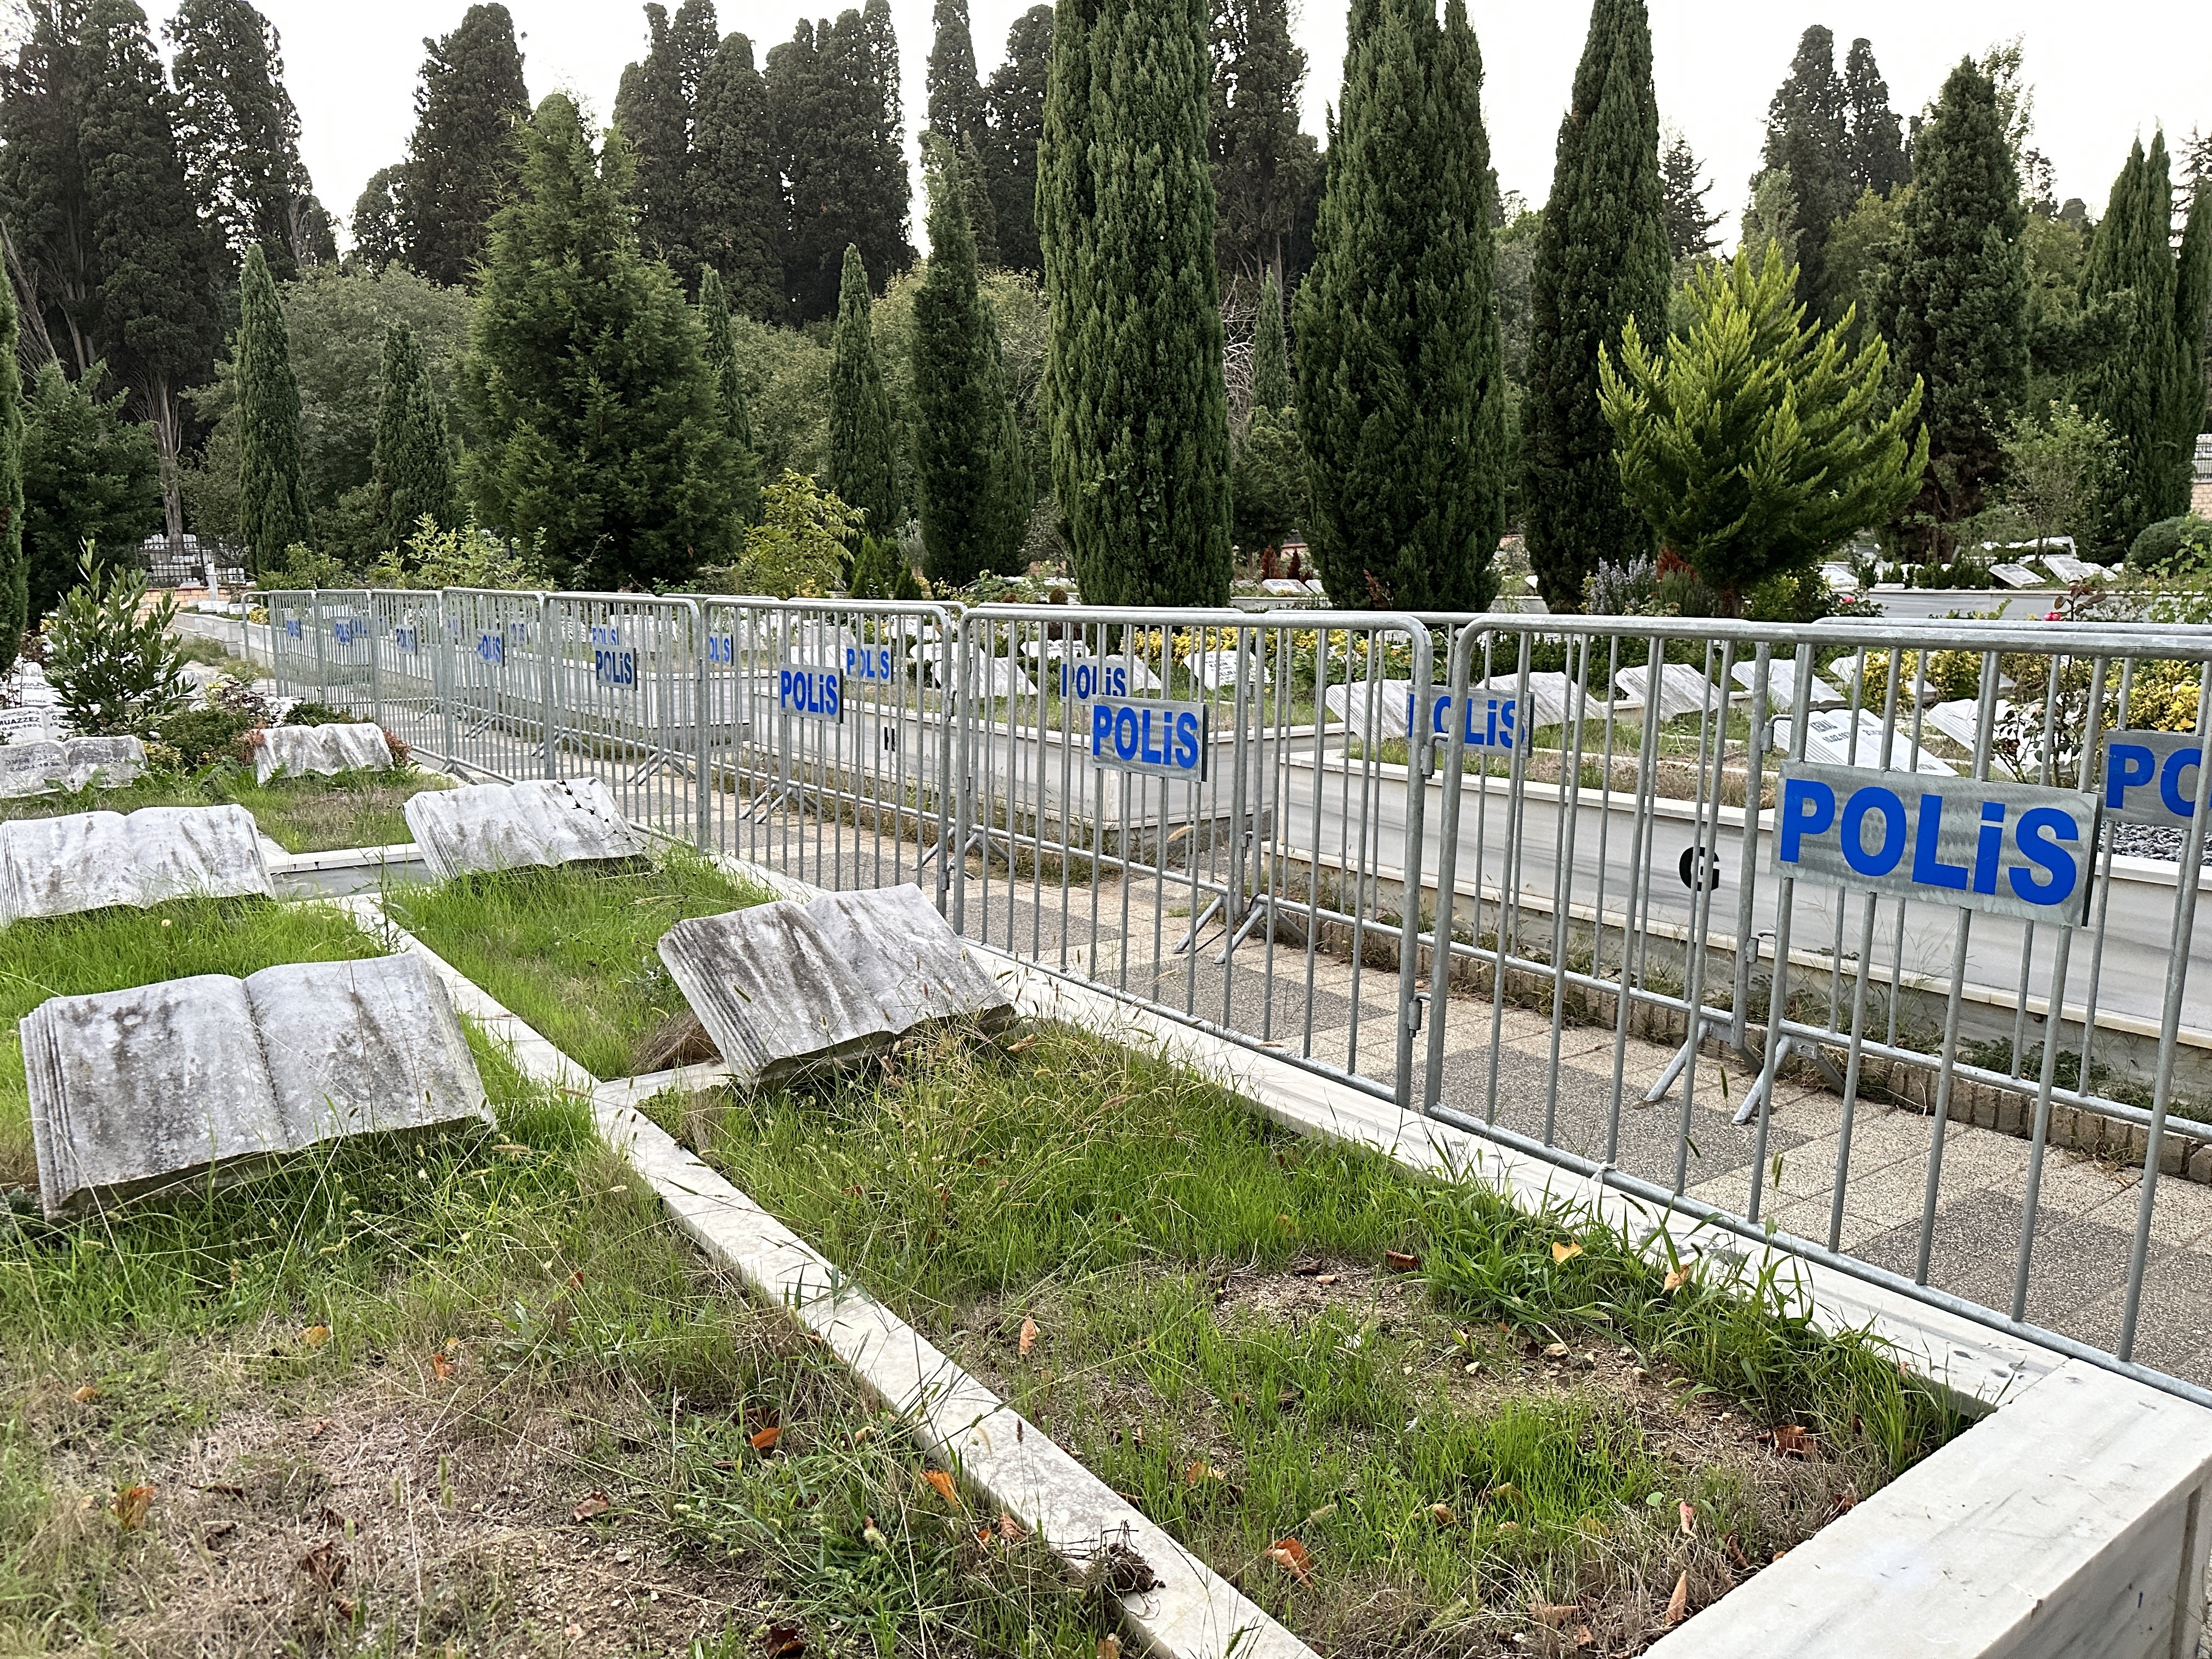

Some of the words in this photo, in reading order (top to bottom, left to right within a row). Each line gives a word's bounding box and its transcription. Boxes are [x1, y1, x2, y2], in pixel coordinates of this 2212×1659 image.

[596, 651, 632, 684] POLiS
[847, 648, 889, 679] POLS
[781, 670, 838, 715] POLiS
[1093, 704, 1198, 769] POLiS
[1780, 778, 2079, 906] POLiS
[1679, 847, 1719, 891] G
